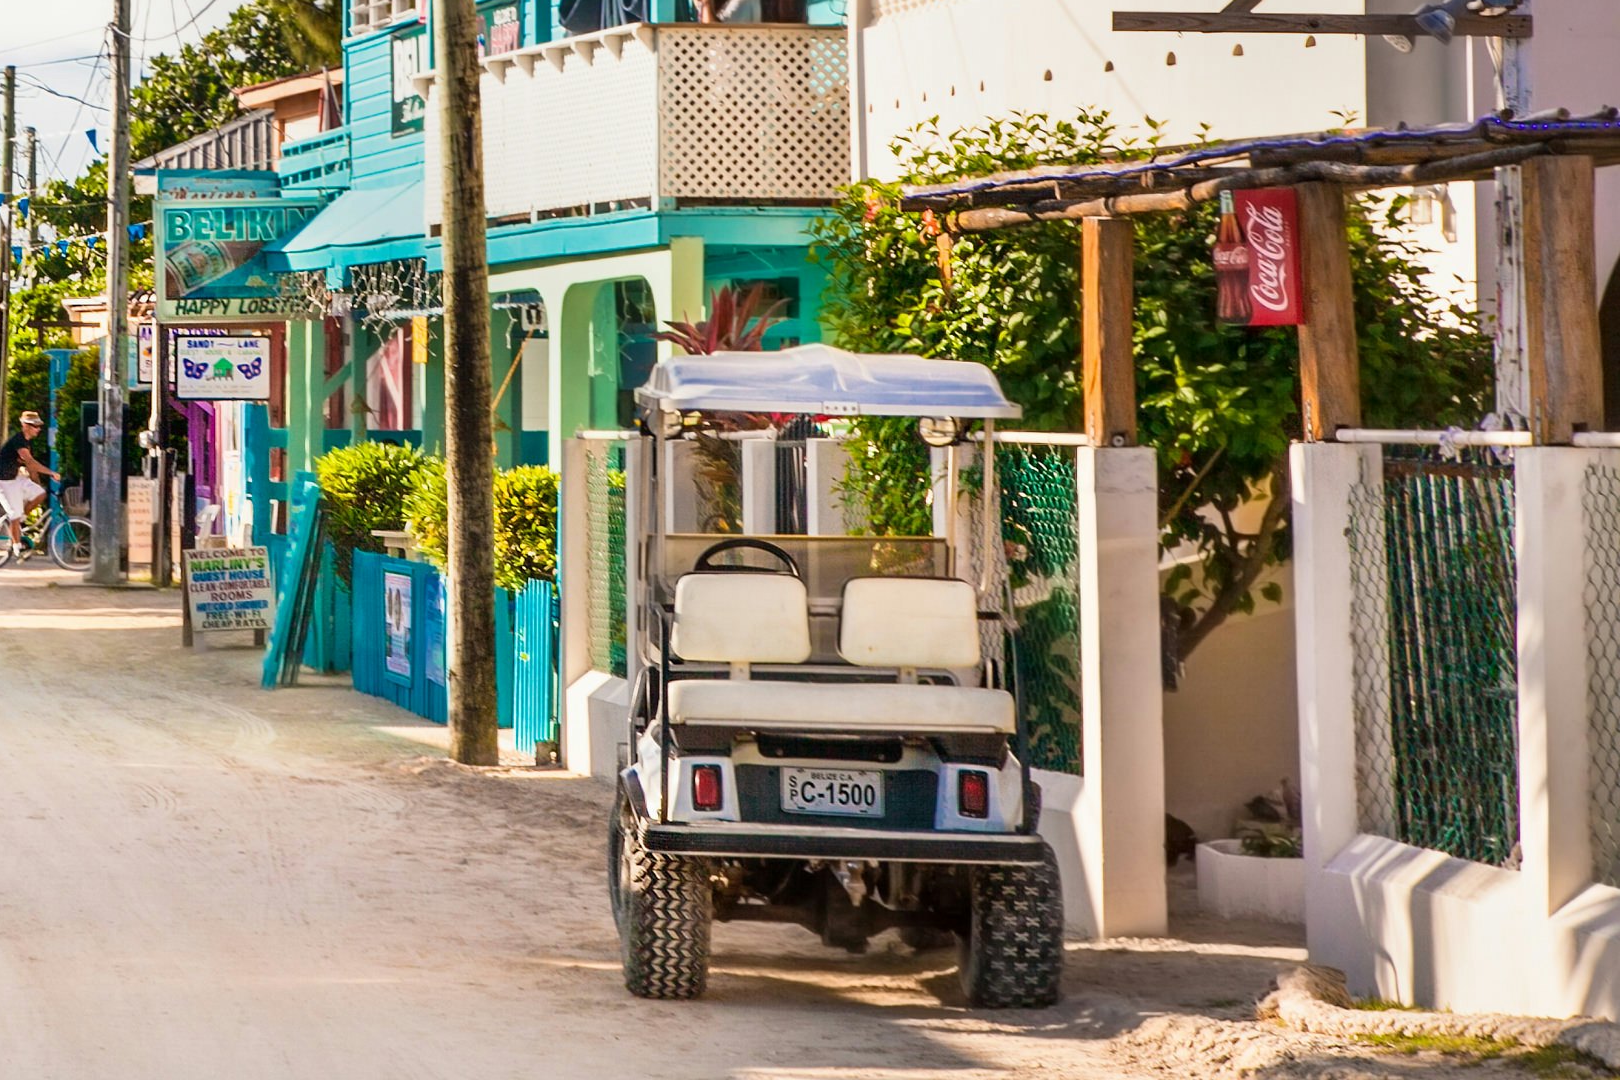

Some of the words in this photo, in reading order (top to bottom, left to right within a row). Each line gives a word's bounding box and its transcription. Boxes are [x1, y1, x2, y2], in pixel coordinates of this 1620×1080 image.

[1246, 200, 1288, 311] Coca-Cola
[176, 299, 230, 316] HAPPY
[187, 339, 214, 348] SANDY
[238, 339, 260, 348] LANE
[188, 549, 246, 560] WELCOME
[250, 548, 266, 556] TO
[192, 571, 226, 582] GUEST
[229, 569, 265, 580] HOUSE
[210, 590, 253, 601] ROOMS
[202, 620, 233, 629] CHEAP
[235, 618, 268, 628] RATES
[811, 772, 837, 780] BELIZE
[801, 781, 876, 806] C-1500
